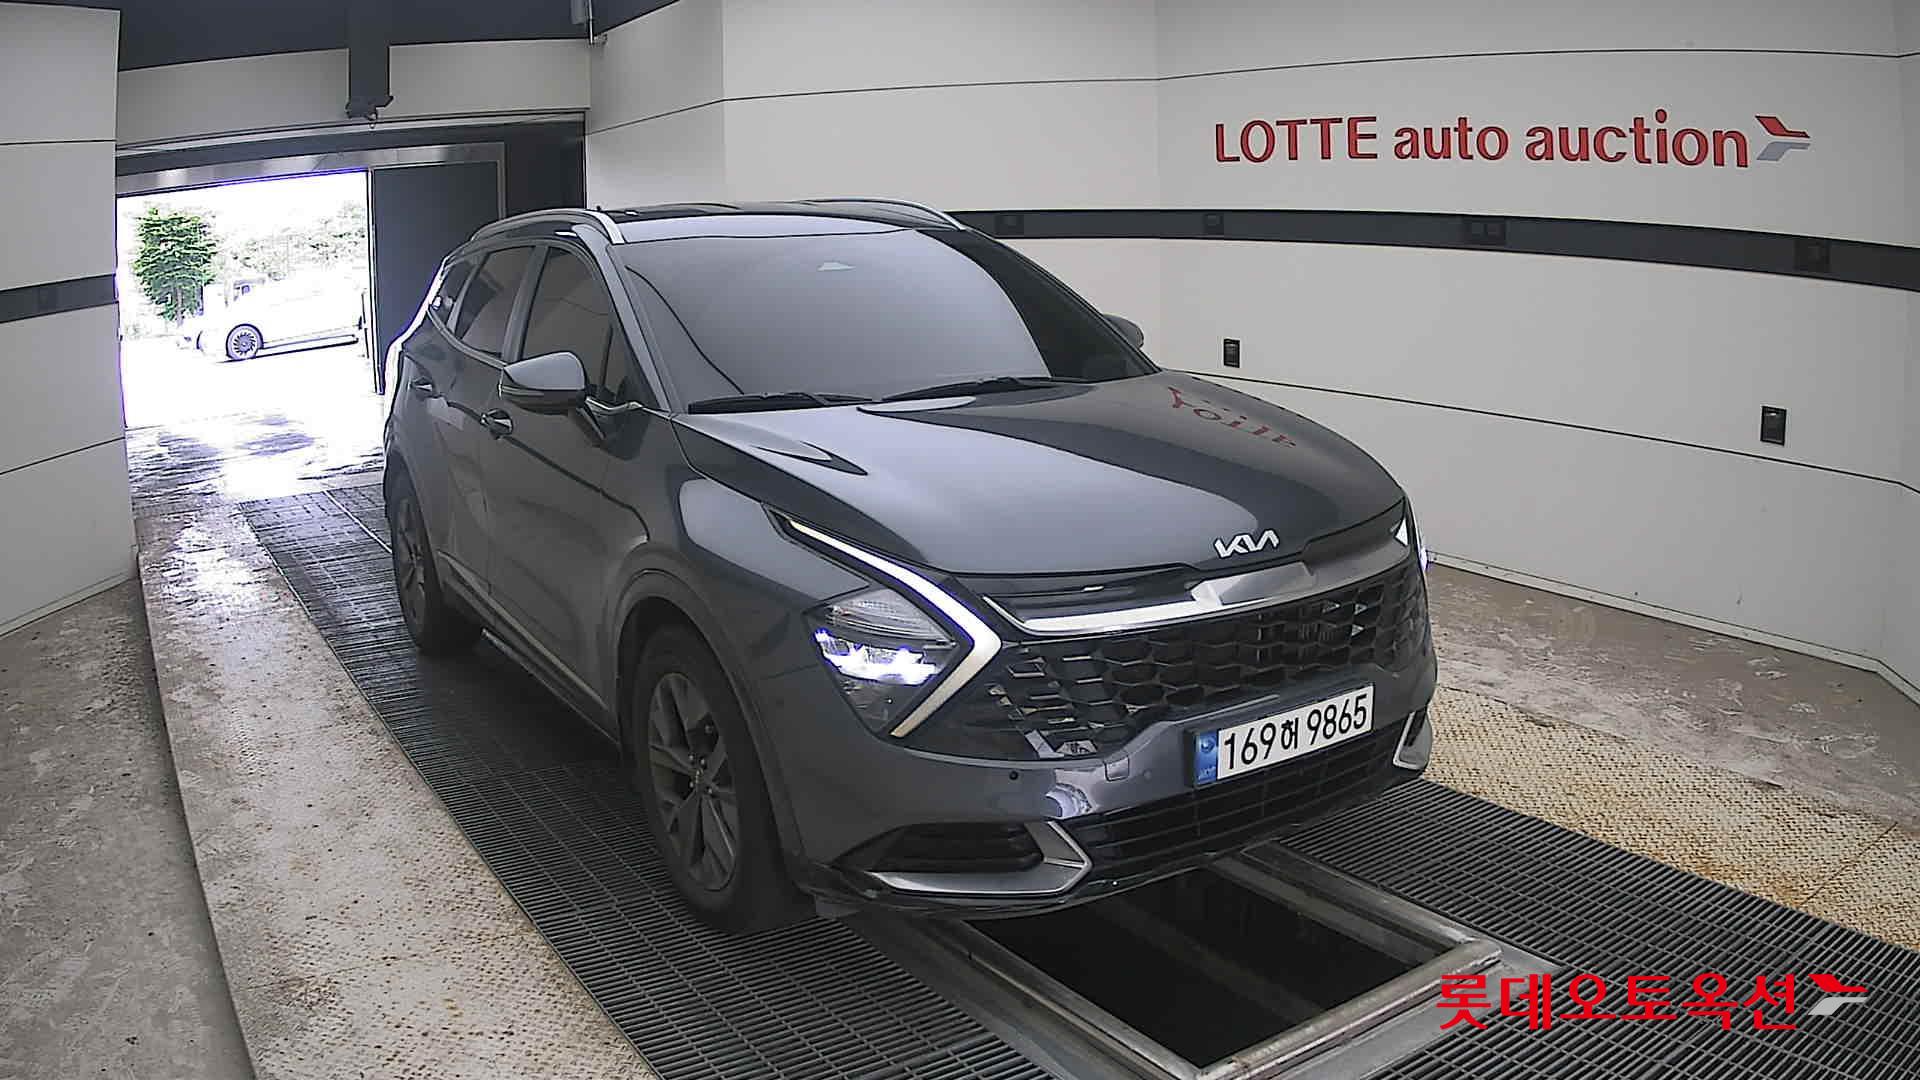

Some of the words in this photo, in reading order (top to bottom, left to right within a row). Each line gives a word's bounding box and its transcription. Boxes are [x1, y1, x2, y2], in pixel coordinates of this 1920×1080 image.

[1214, 116, 1378, 163] LOTTE
[1394, 116, 1509, 161] auto
[1525, 109, 1749, 168] auction
[1213, 529, 1280, 558] KIA
